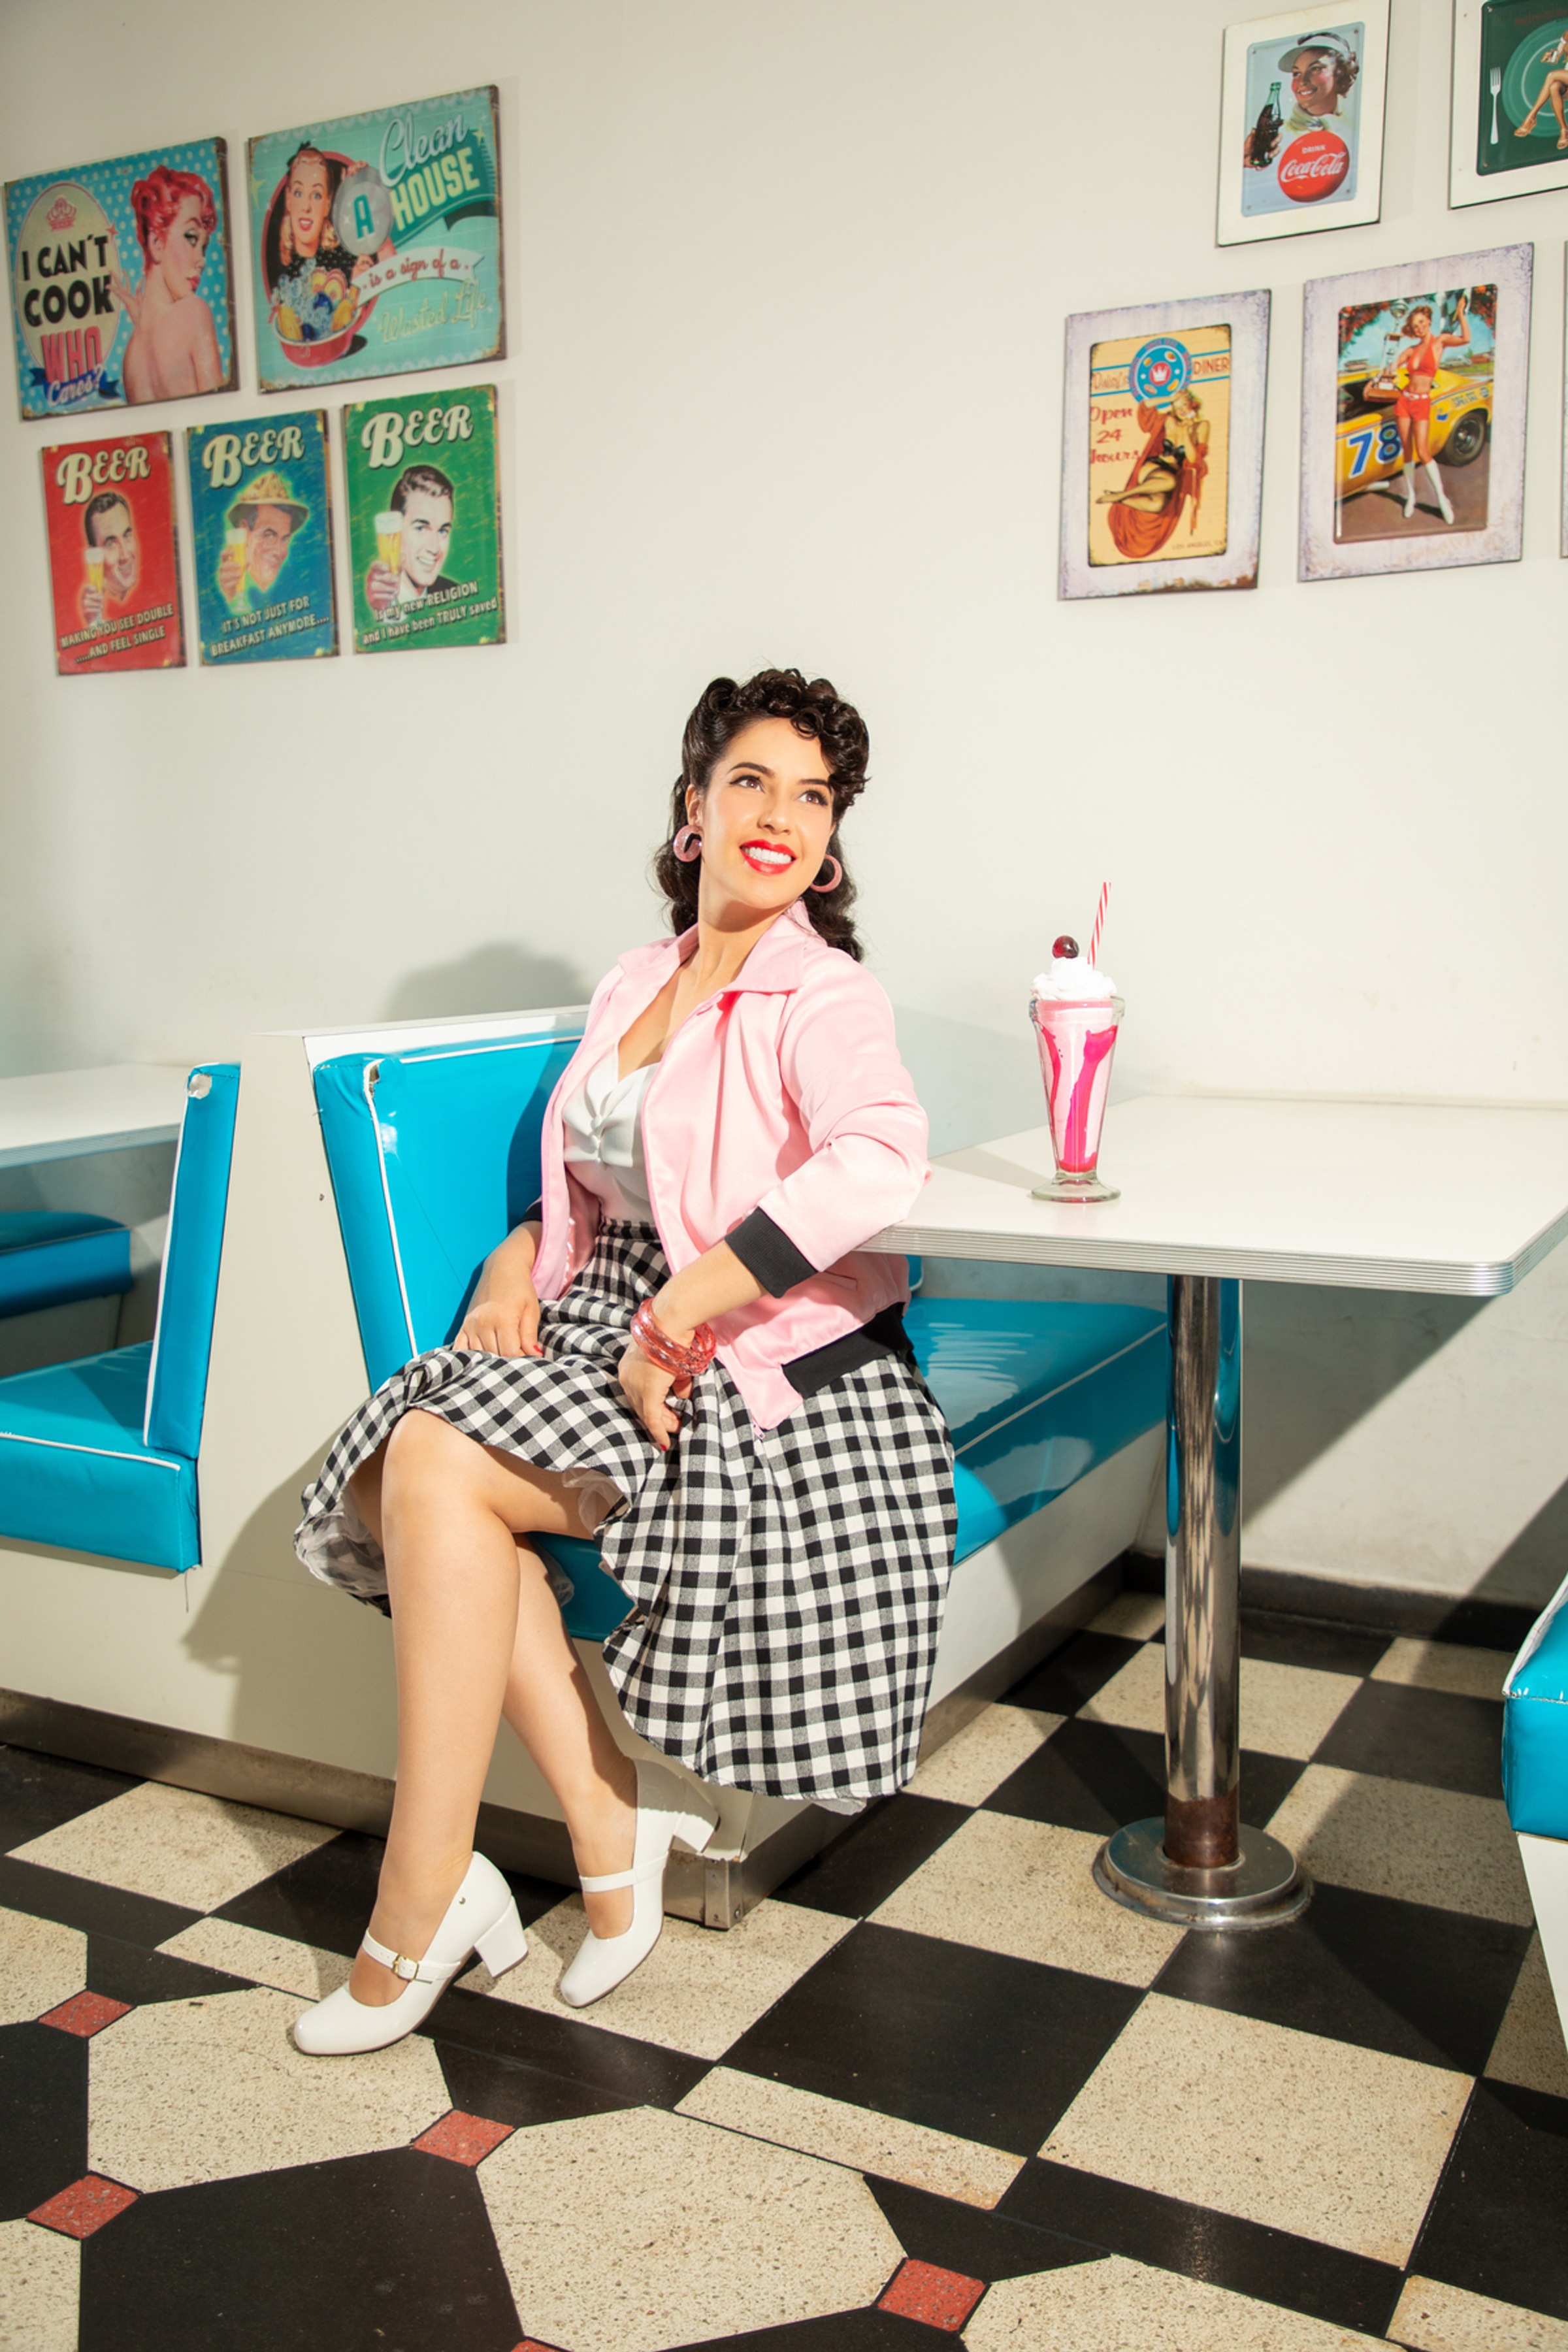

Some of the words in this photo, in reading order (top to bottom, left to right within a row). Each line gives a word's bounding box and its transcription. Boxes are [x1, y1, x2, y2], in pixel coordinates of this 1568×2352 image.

[380, 110, 470, 188] Clean
[1301, 144, 1327, 154] DRINK
[353, 194, 374, 240] A
[390, 146, 480, 231] HOUSE
[22, 250, 31, 281] I
[368, 272, 382, 287] is
[385, 269, 396, 280] a
[400, 257, 429, 281] sign
[432, 248, 446, 278] of
[449, 258, 461, 269] a
[24, 274, 115, 327] COOK
[378, 290, 448, 343] Wasted
[450, 278, 488, 329] Life
[41, 326, 103, 385] WHO
[47, 364, 105, 407] Cares?
[1096, 429, 1122, 444] 24
[1348, 421, 1403, 478] 78
[221, 617, 241, 634] IT'S
[241, 610, 263, 630] NOT
[264, 602, 287, 621] JUST
[288, 595, 310, 613] FOR
[363, 629, 380, 646] and
[387, 623, 411, 639] have
[412, 615, 436, 633] been
[436, 604, 468, 625] TRULY
[469, 596, 498, 617] saved
[385, 604, 402, 621] my
[403, 599, 425, 615] new
[427, 580, 480, 609] RELIGION
[60, 629, 97, 649] MAKING
[97, 621, 118, 638] YOU
[118, 616, 136, 631] SEE
[136, 603, 174, 627] DOUBLE
[110, 636, 131, 652] FEEL
[133, 625, 166, 645] SINGLE
[210, 629, 266, 659] BREAKFAST
